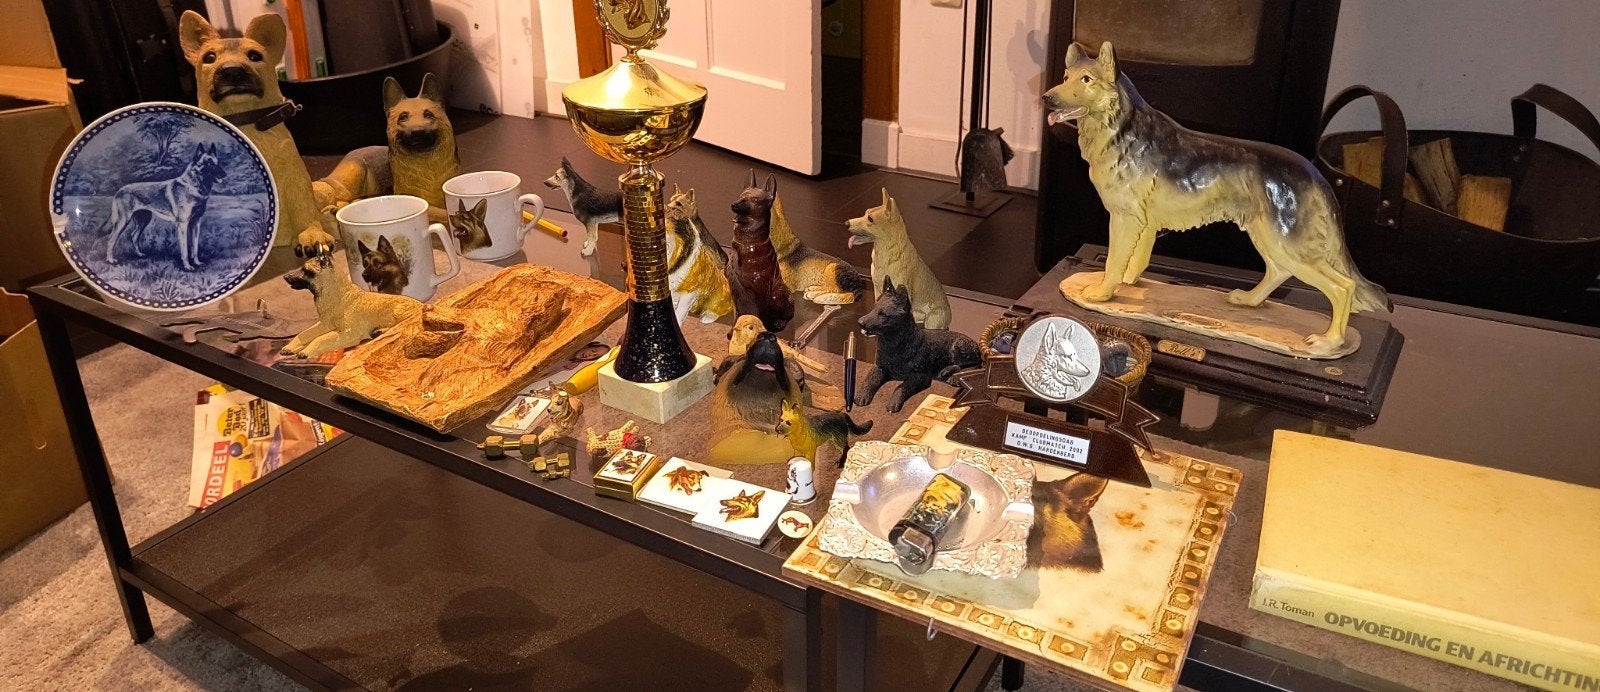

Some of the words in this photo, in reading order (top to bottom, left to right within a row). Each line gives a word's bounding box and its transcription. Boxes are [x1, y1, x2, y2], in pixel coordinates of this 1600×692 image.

[203, 444, 229, 507] ORDEEL
[1280, 601, 1315, 618] Toman
[1324, 611, 1442, 653] OPVOEDING
[1445, 641, 1475, 661] EN
